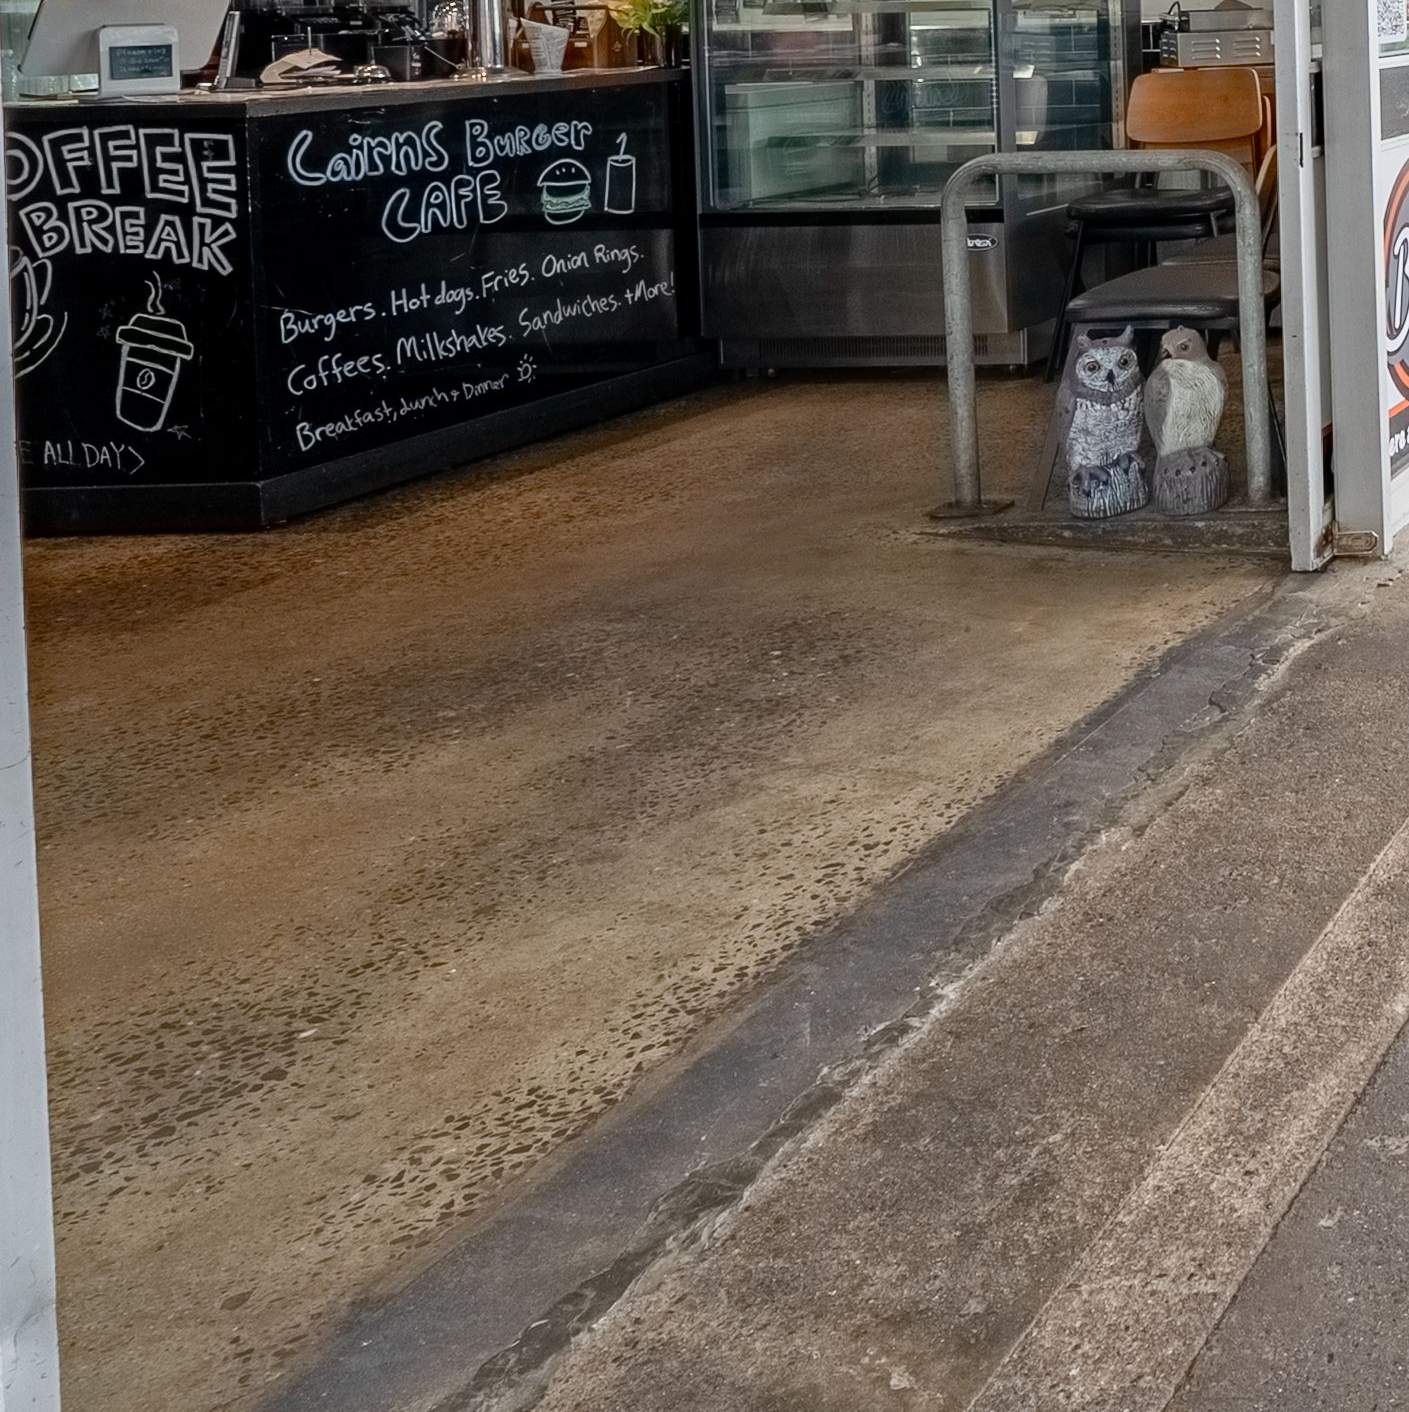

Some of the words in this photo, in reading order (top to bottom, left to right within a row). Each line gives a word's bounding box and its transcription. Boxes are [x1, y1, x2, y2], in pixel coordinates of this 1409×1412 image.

[6, 125, 237, 219] OFFEE
[287, 120, 450, 186] Cairns
[19, 199, 237, 276] BREAK
[381, 170, 508, 243] CAFE
[390, 283, 432, 316] Hot
[541, 250, 590, 278] Onion
[1389, 430, 1406, 456] ere
